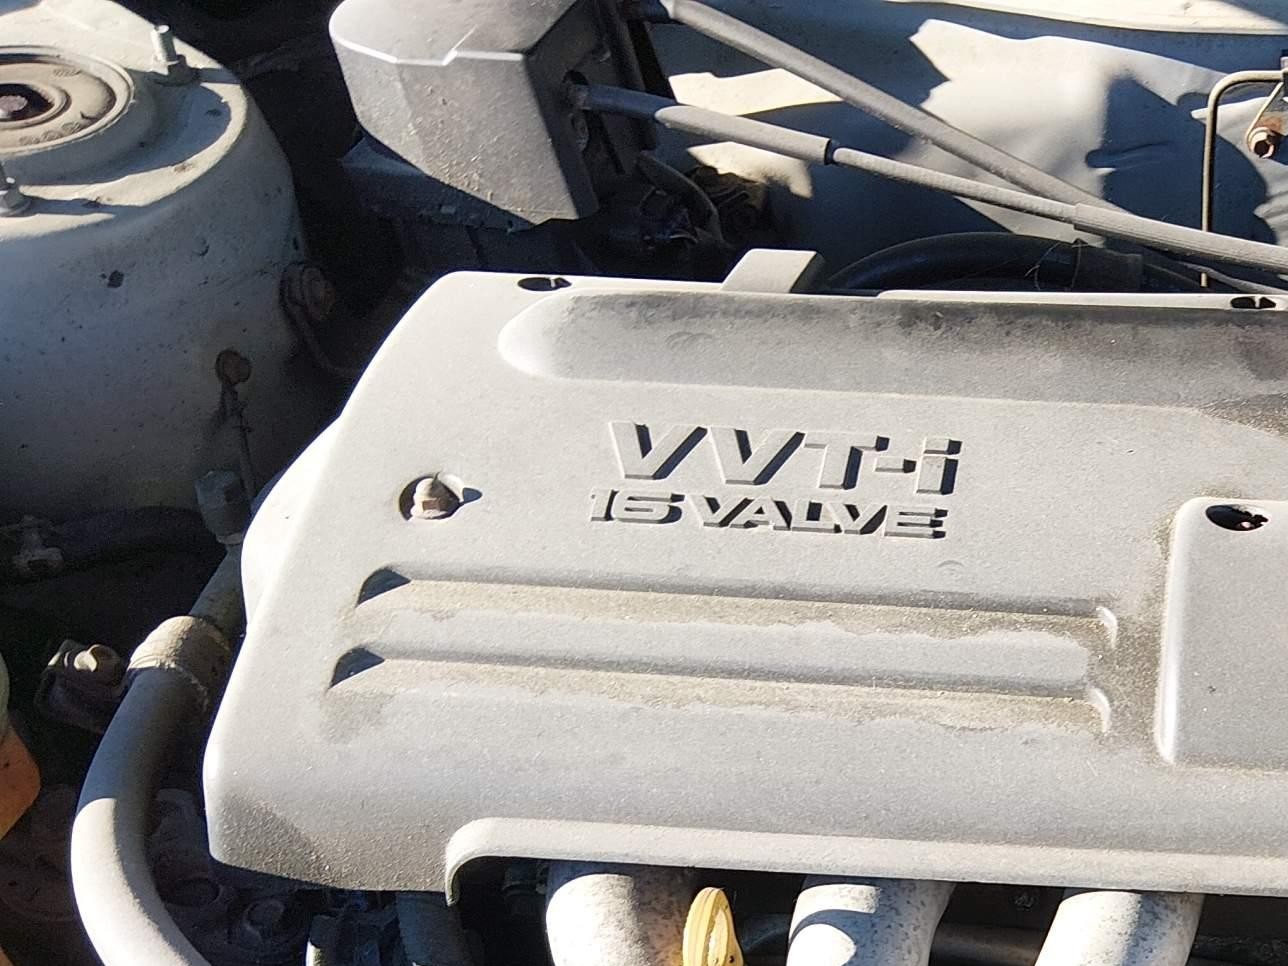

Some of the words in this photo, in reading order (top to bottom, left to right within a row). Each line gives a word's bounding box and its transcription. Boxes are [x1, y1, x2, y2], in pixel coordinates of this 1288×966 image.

[609, 421, 962, 494] VVT-i
[590, 488, 685, 524] 16
[690, 494, 949, 539] VALVE
